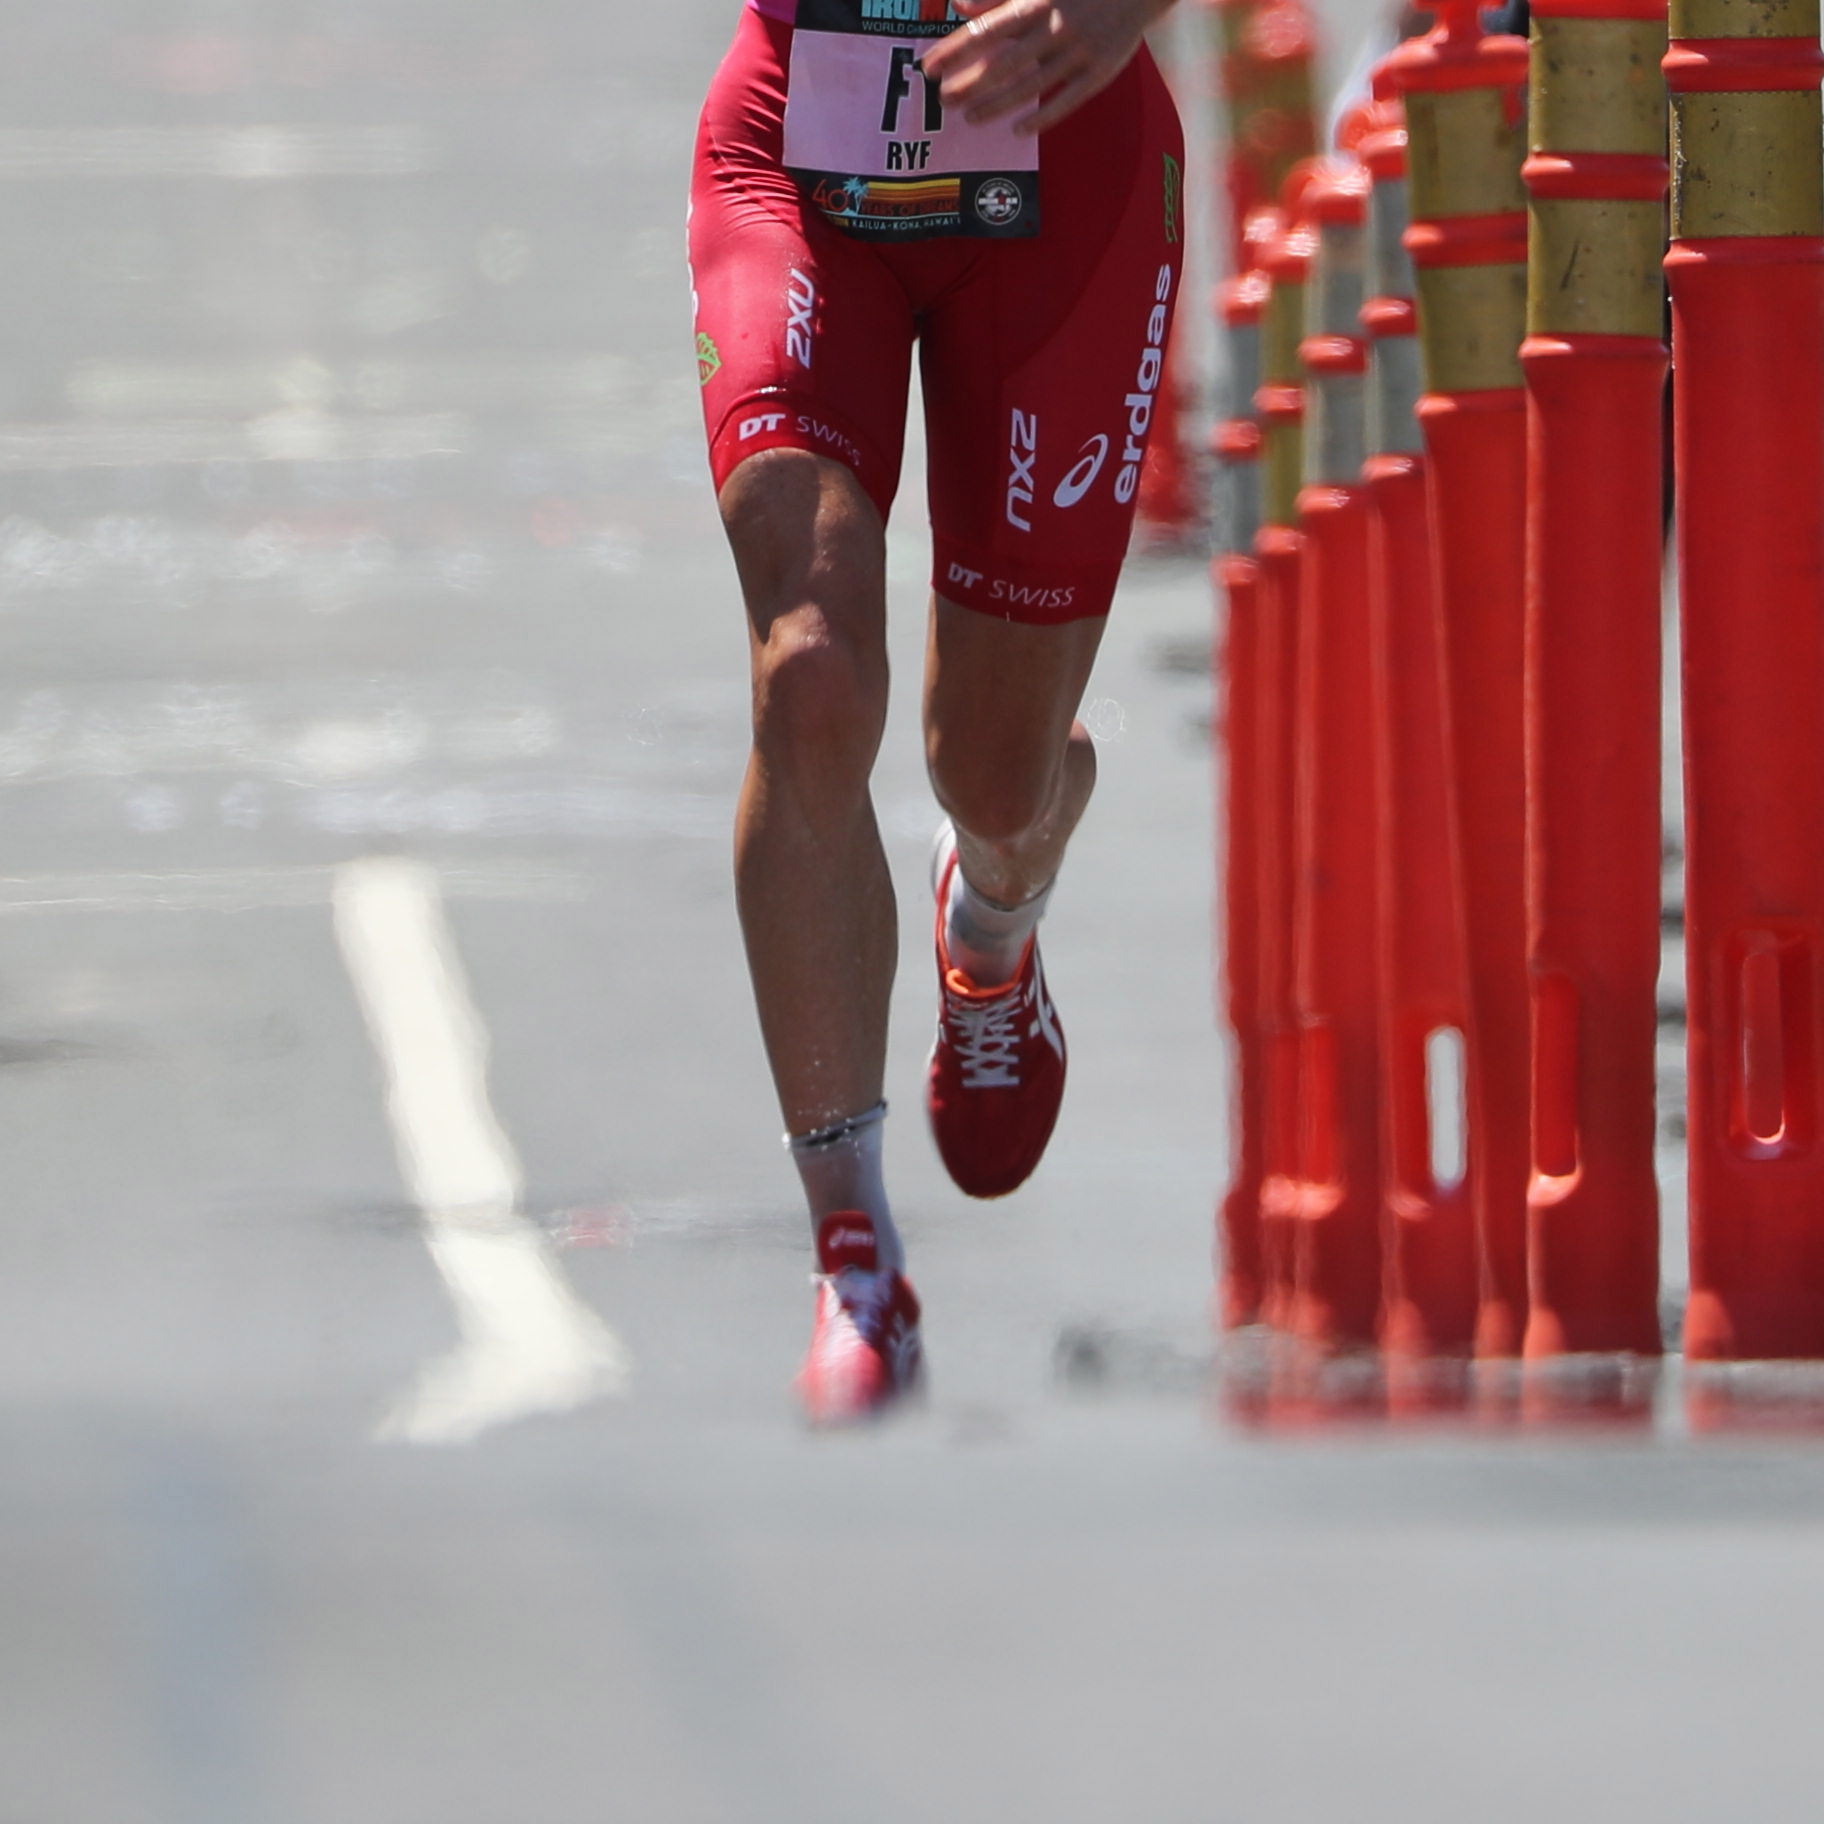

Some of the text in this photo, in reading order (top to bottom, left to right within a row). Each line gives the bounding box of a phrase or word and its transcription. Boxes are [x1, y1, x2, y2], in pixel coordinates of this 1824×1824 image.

[861, 21, 905, 34] WORLD
[884, 139, 932, 172] RYF
[786, 268, 815, 369] 2XU
[1114, 263, 1172, 505] erdgas
[738, 413, 861, 467] DT SWISS
[1006, 407, 1037, 532] 2XU
[947, 562, 1076, 609] DT SWISS
